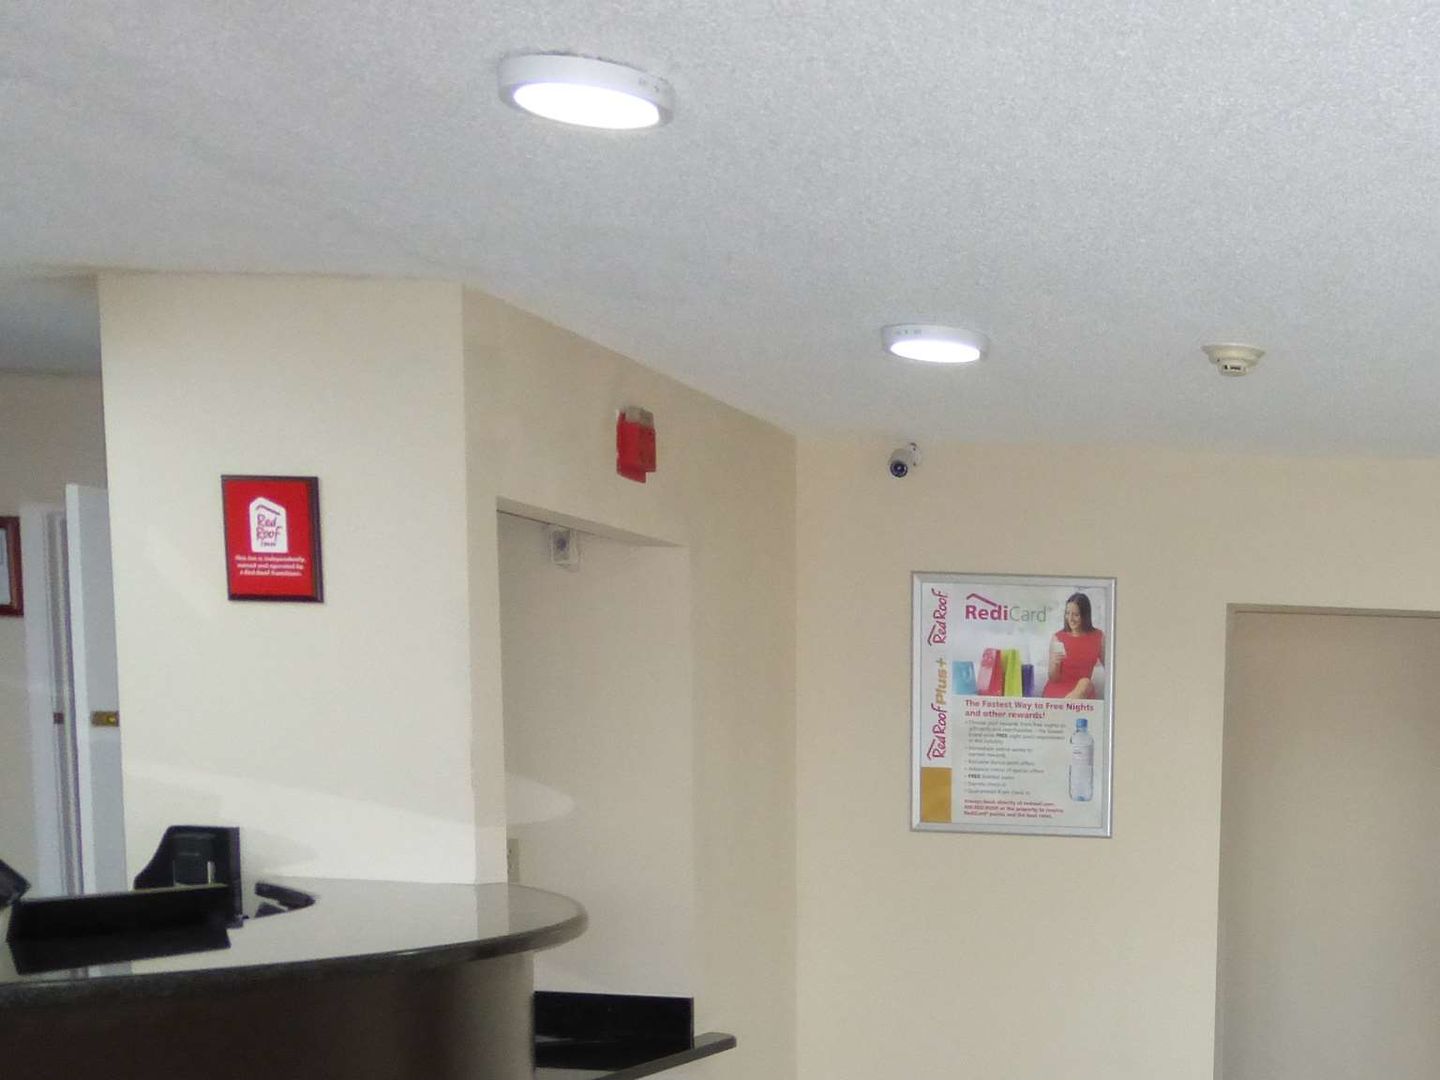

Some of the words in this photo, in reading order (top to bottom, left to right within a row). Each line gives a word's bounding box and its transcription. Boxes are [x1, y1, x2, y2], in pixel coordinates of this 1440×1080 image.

[257, 513, 277, 528] Red
[256, 526, 282, 542] Roof
[965, 700, 981, 708] The
[982, 701, 1013, 709] Fastest
[1015, 702, 1033, 711] Way
[1046, 703, 1063, 711] Free
[1066, 703, 1095, 712] Nights
[965, 709, 981, 718] and
[983, 710, 1006, 718] other
[1008, 711, 1046, 719] rewards!
